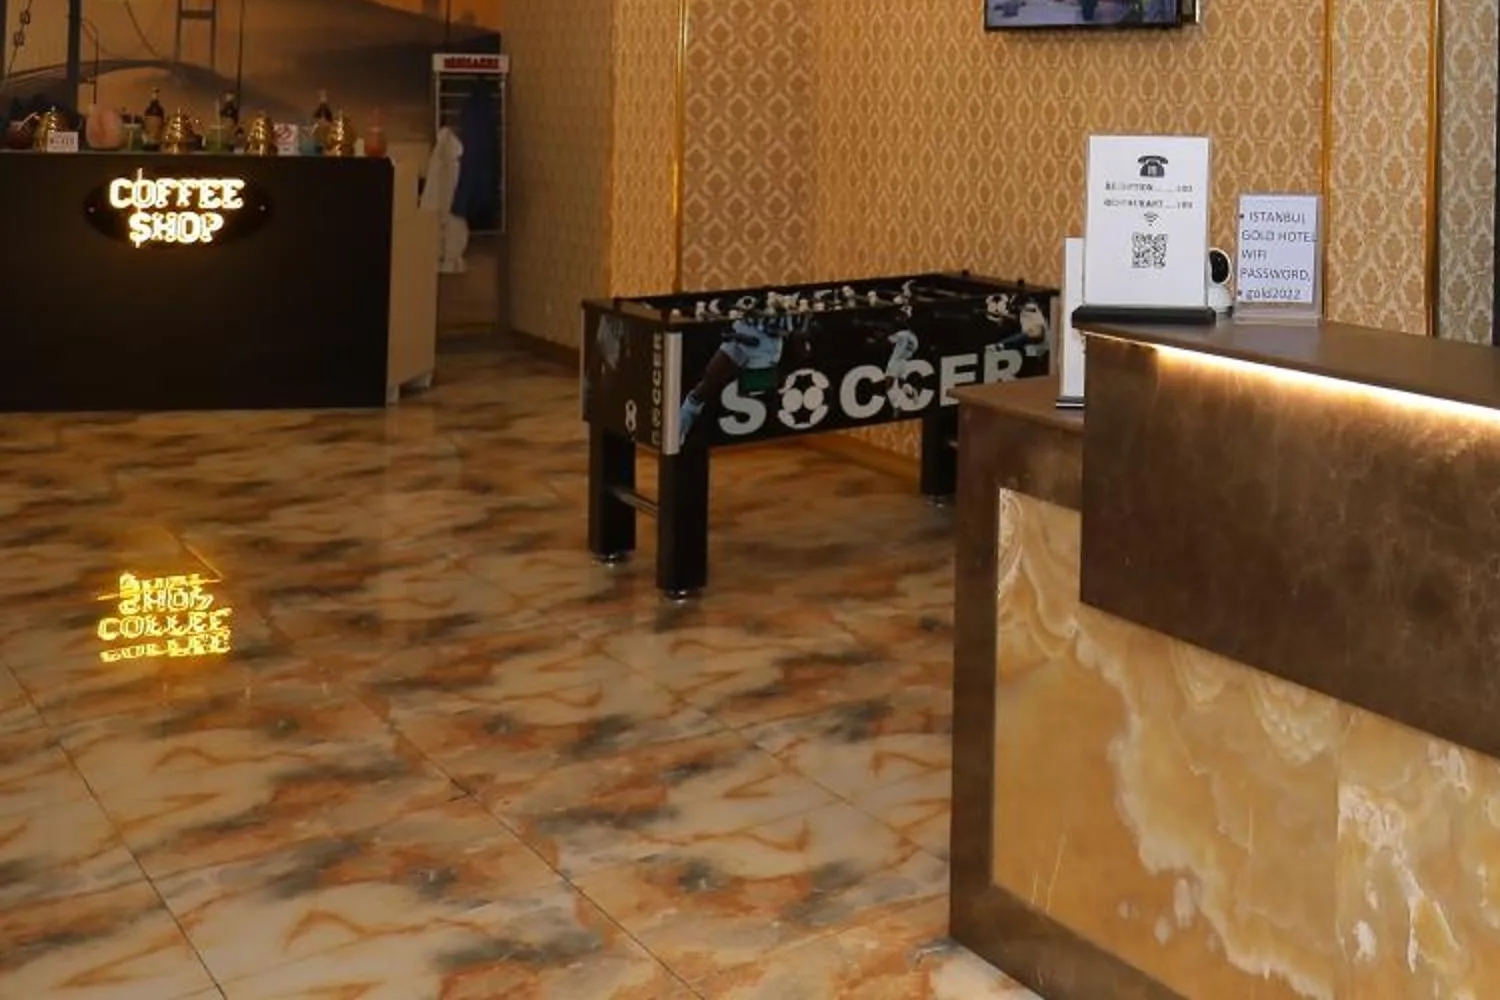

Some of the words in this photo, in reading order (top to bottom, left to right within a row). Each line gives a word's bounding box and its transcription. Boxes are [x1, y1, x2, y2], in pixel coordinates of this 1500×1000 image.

[109, 178, 245, 209] COFFEE
[129, 211, 224, 245] SHOP
[1242, 230, 1275, 241] GOLD
[719, 348, 1024, 436] SOCCER
